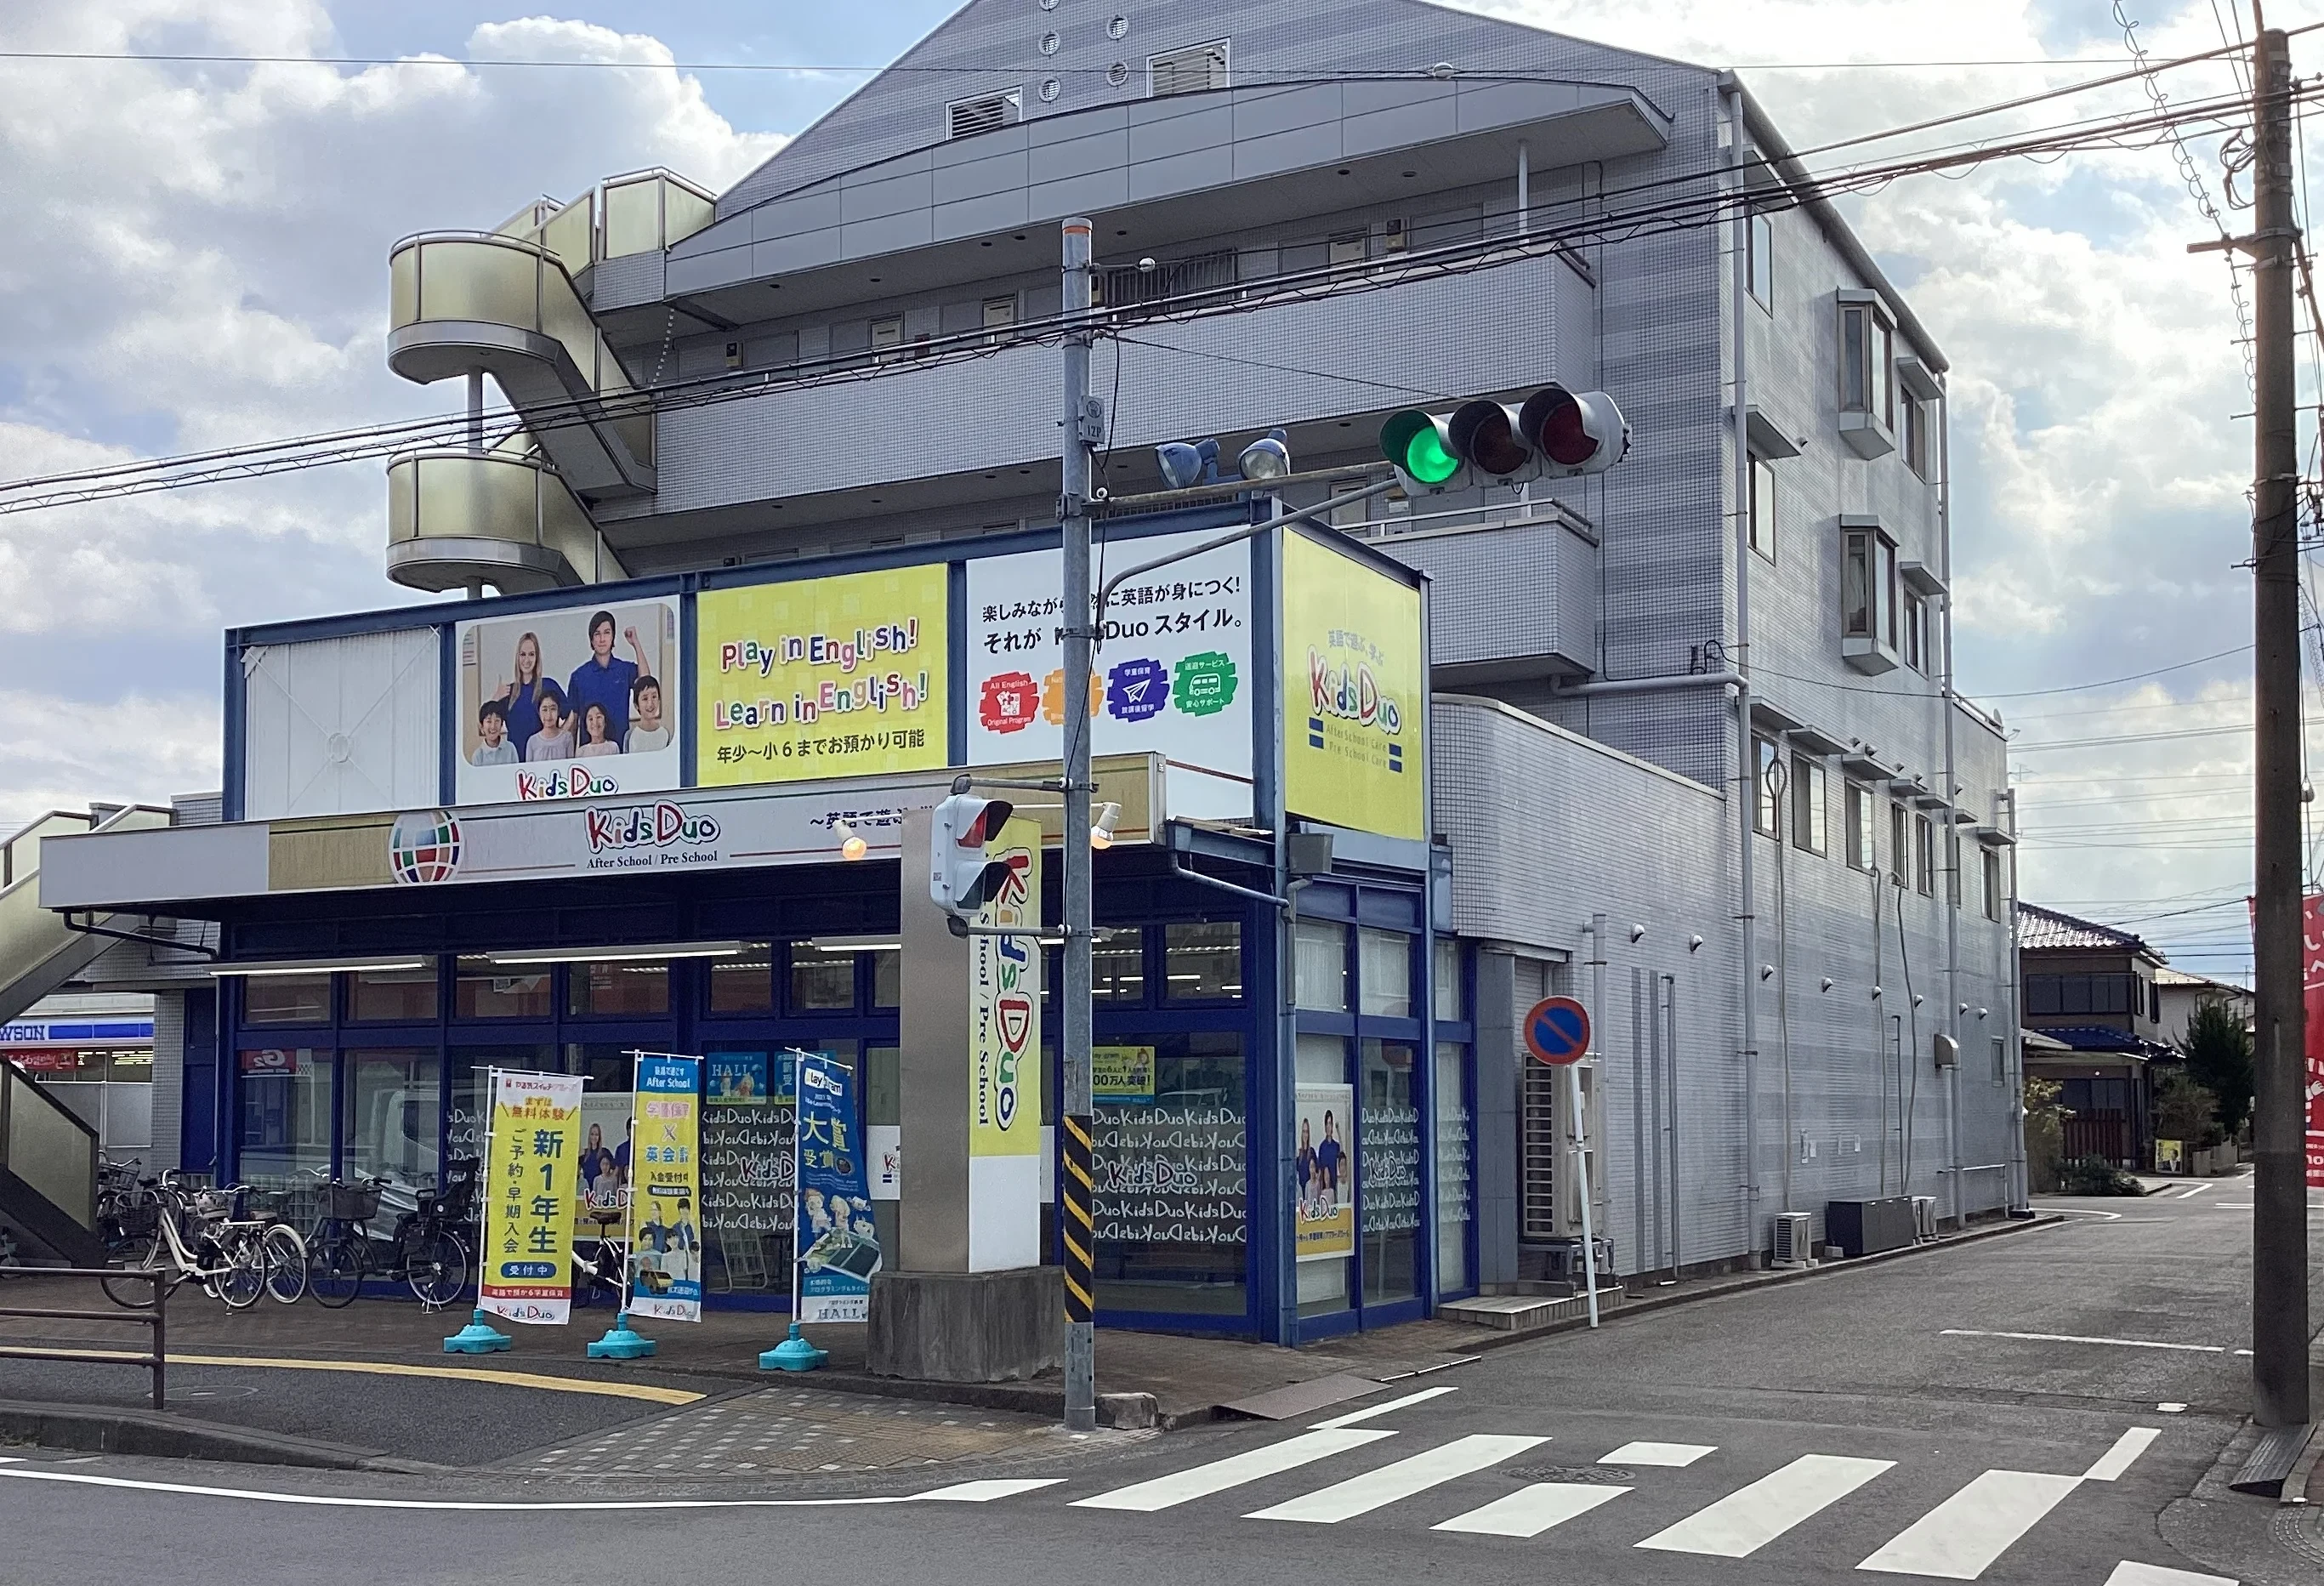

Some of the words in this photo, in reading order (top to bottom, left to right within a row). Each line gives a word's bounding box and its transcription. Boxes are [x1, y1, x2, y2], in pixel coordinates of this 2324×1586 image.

[982, 577, 1240, 622] 楽しみながに英語が身につく!
[721, 640, 775, 675] Play
[780, 636, 804, 663] in
[810, 617, 918, 671] English!
[984, 627, 1042, 654] それが
[1002, 680, 1029, 689] English
[1309, 647, 1400, 731] KidsDuo
[715, 700, 787, 730] Learn
[793, 692, 818, 722] in
[818, 671, 927, 712] English!
[517, 765, 617, 800] KidsDuo
[586, 801, 719, 852] KidsDuo
[587, 856, 614, 869] After
[617, 854, 651, 867] School
[661, 853, 679, 865] Pre
[681, 850, 718, 863] School
[980, 912, 989, 986] Shool
[980, 1006, 990, 1043] Pre
[646, 1077, 666, 1088] After
[667, 1077, 690, 1089] School
[712, 1064, 747, 1077] HALL
[980, 1050, 990, 1125] School
[511, 1105, 565, 1121] 無料体験
[1108, 1160, 1197, 1188] KidsDuo
[527, 1128, 564, 1254] 新1年生
[584, 1188, 634, 1210] KidsD
[1299, 1195, 1339, 1224] KidsDuo
[509, 1264, 548, 1276] 受付中
[818, 1308, 861, 1320] HALL
